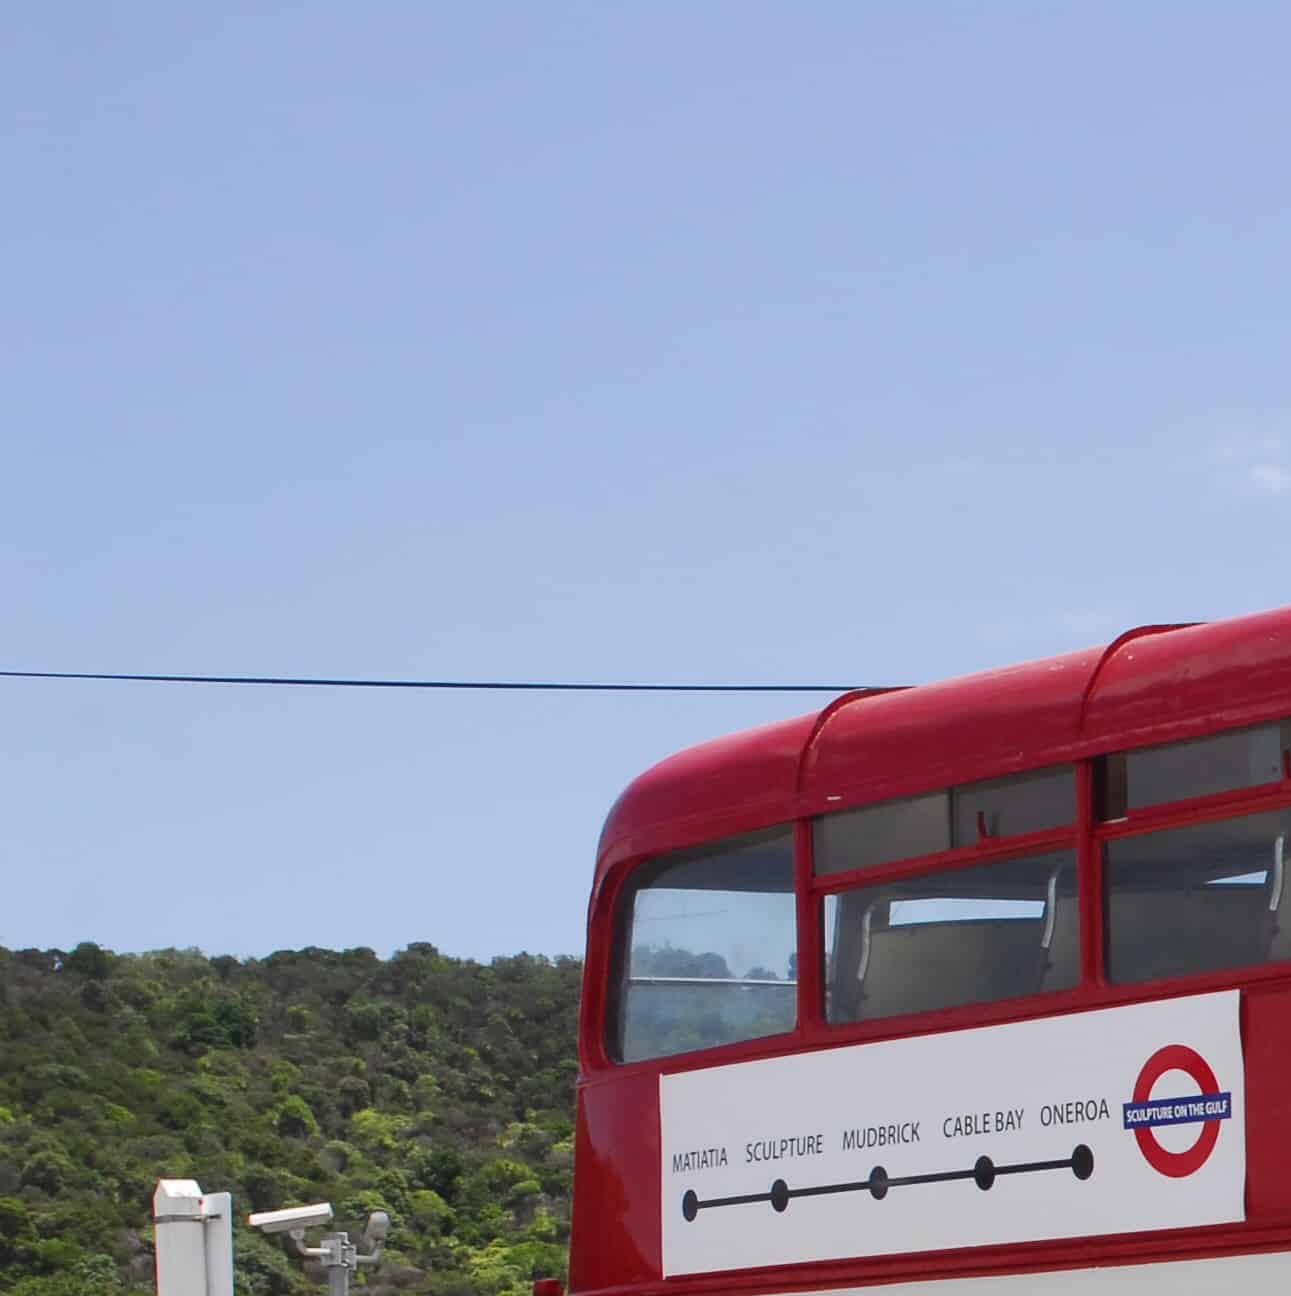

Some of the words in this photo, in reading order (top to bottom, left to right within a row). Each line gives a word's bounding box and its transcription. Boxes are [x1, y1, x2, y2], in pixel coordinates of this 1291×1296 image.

[672, 1147, 728, 1173] MATIATIA
[745, 1134, 824, 1163] SCULPTURE
[842, 1121, 921, 1152] MUDBRICK
[942, 1113, 991, 1139] CABLE
[994, 1109, 1025, 1133] BAY
[1040, 1098, 1110, 1128] ONEROA
[1126, 1105, 1173, 1123] SCULPTURE
[1174, 1104, 1188, 1118] ON
[1189, 1102, 1205, 1117] THE
[1205, 1100, 1227, 1115] GULF
